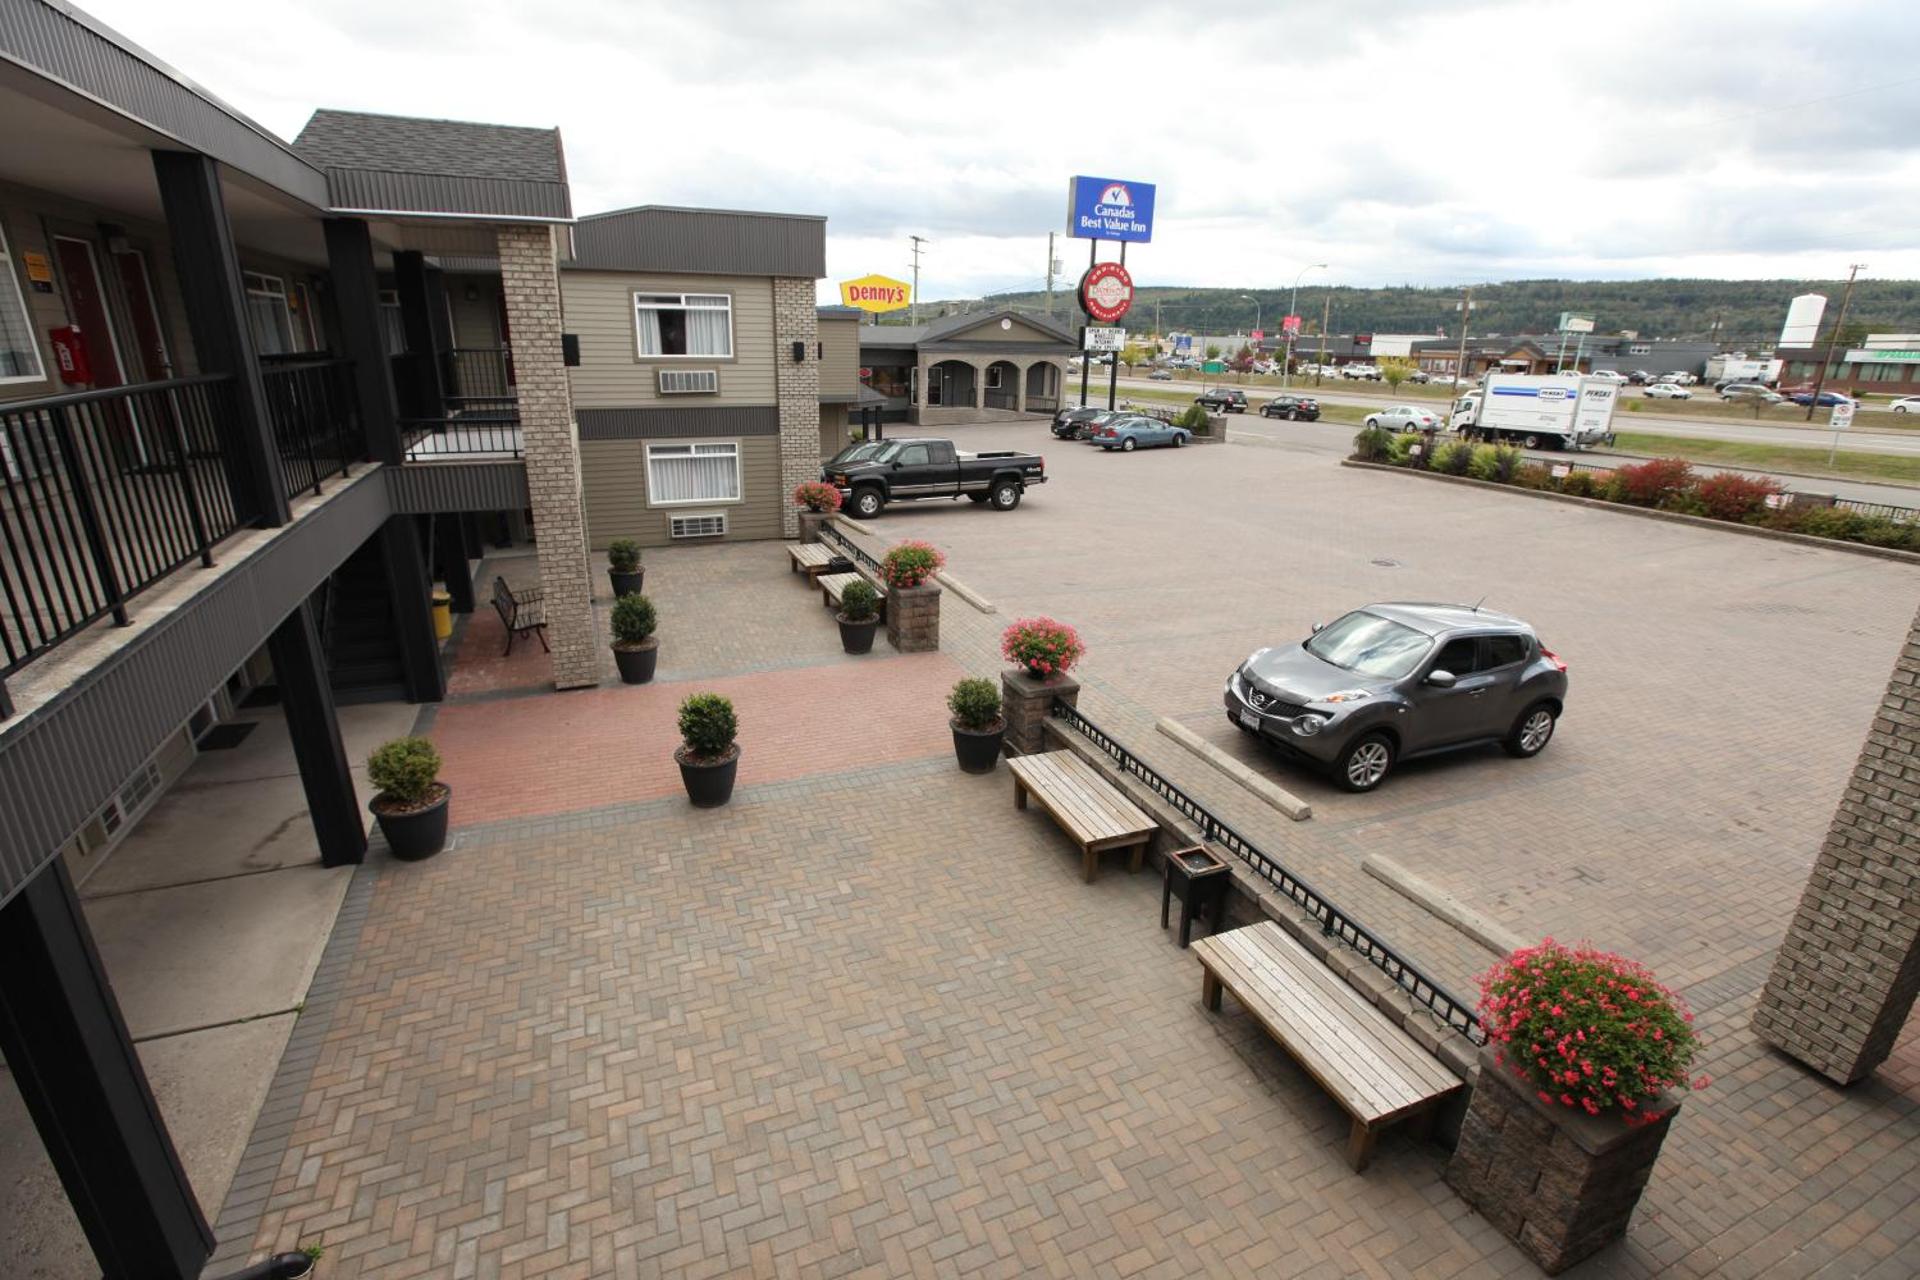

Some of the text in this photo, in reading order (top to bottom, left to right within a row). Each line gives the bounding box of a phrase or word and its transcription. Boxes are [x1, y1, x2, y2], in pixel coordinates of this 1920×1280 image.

[1094, 204, 1135, 219] Canadas
[1081, 216, 1146, 233] Best Value Inn
[849, 286, 904, 304] Denny's
